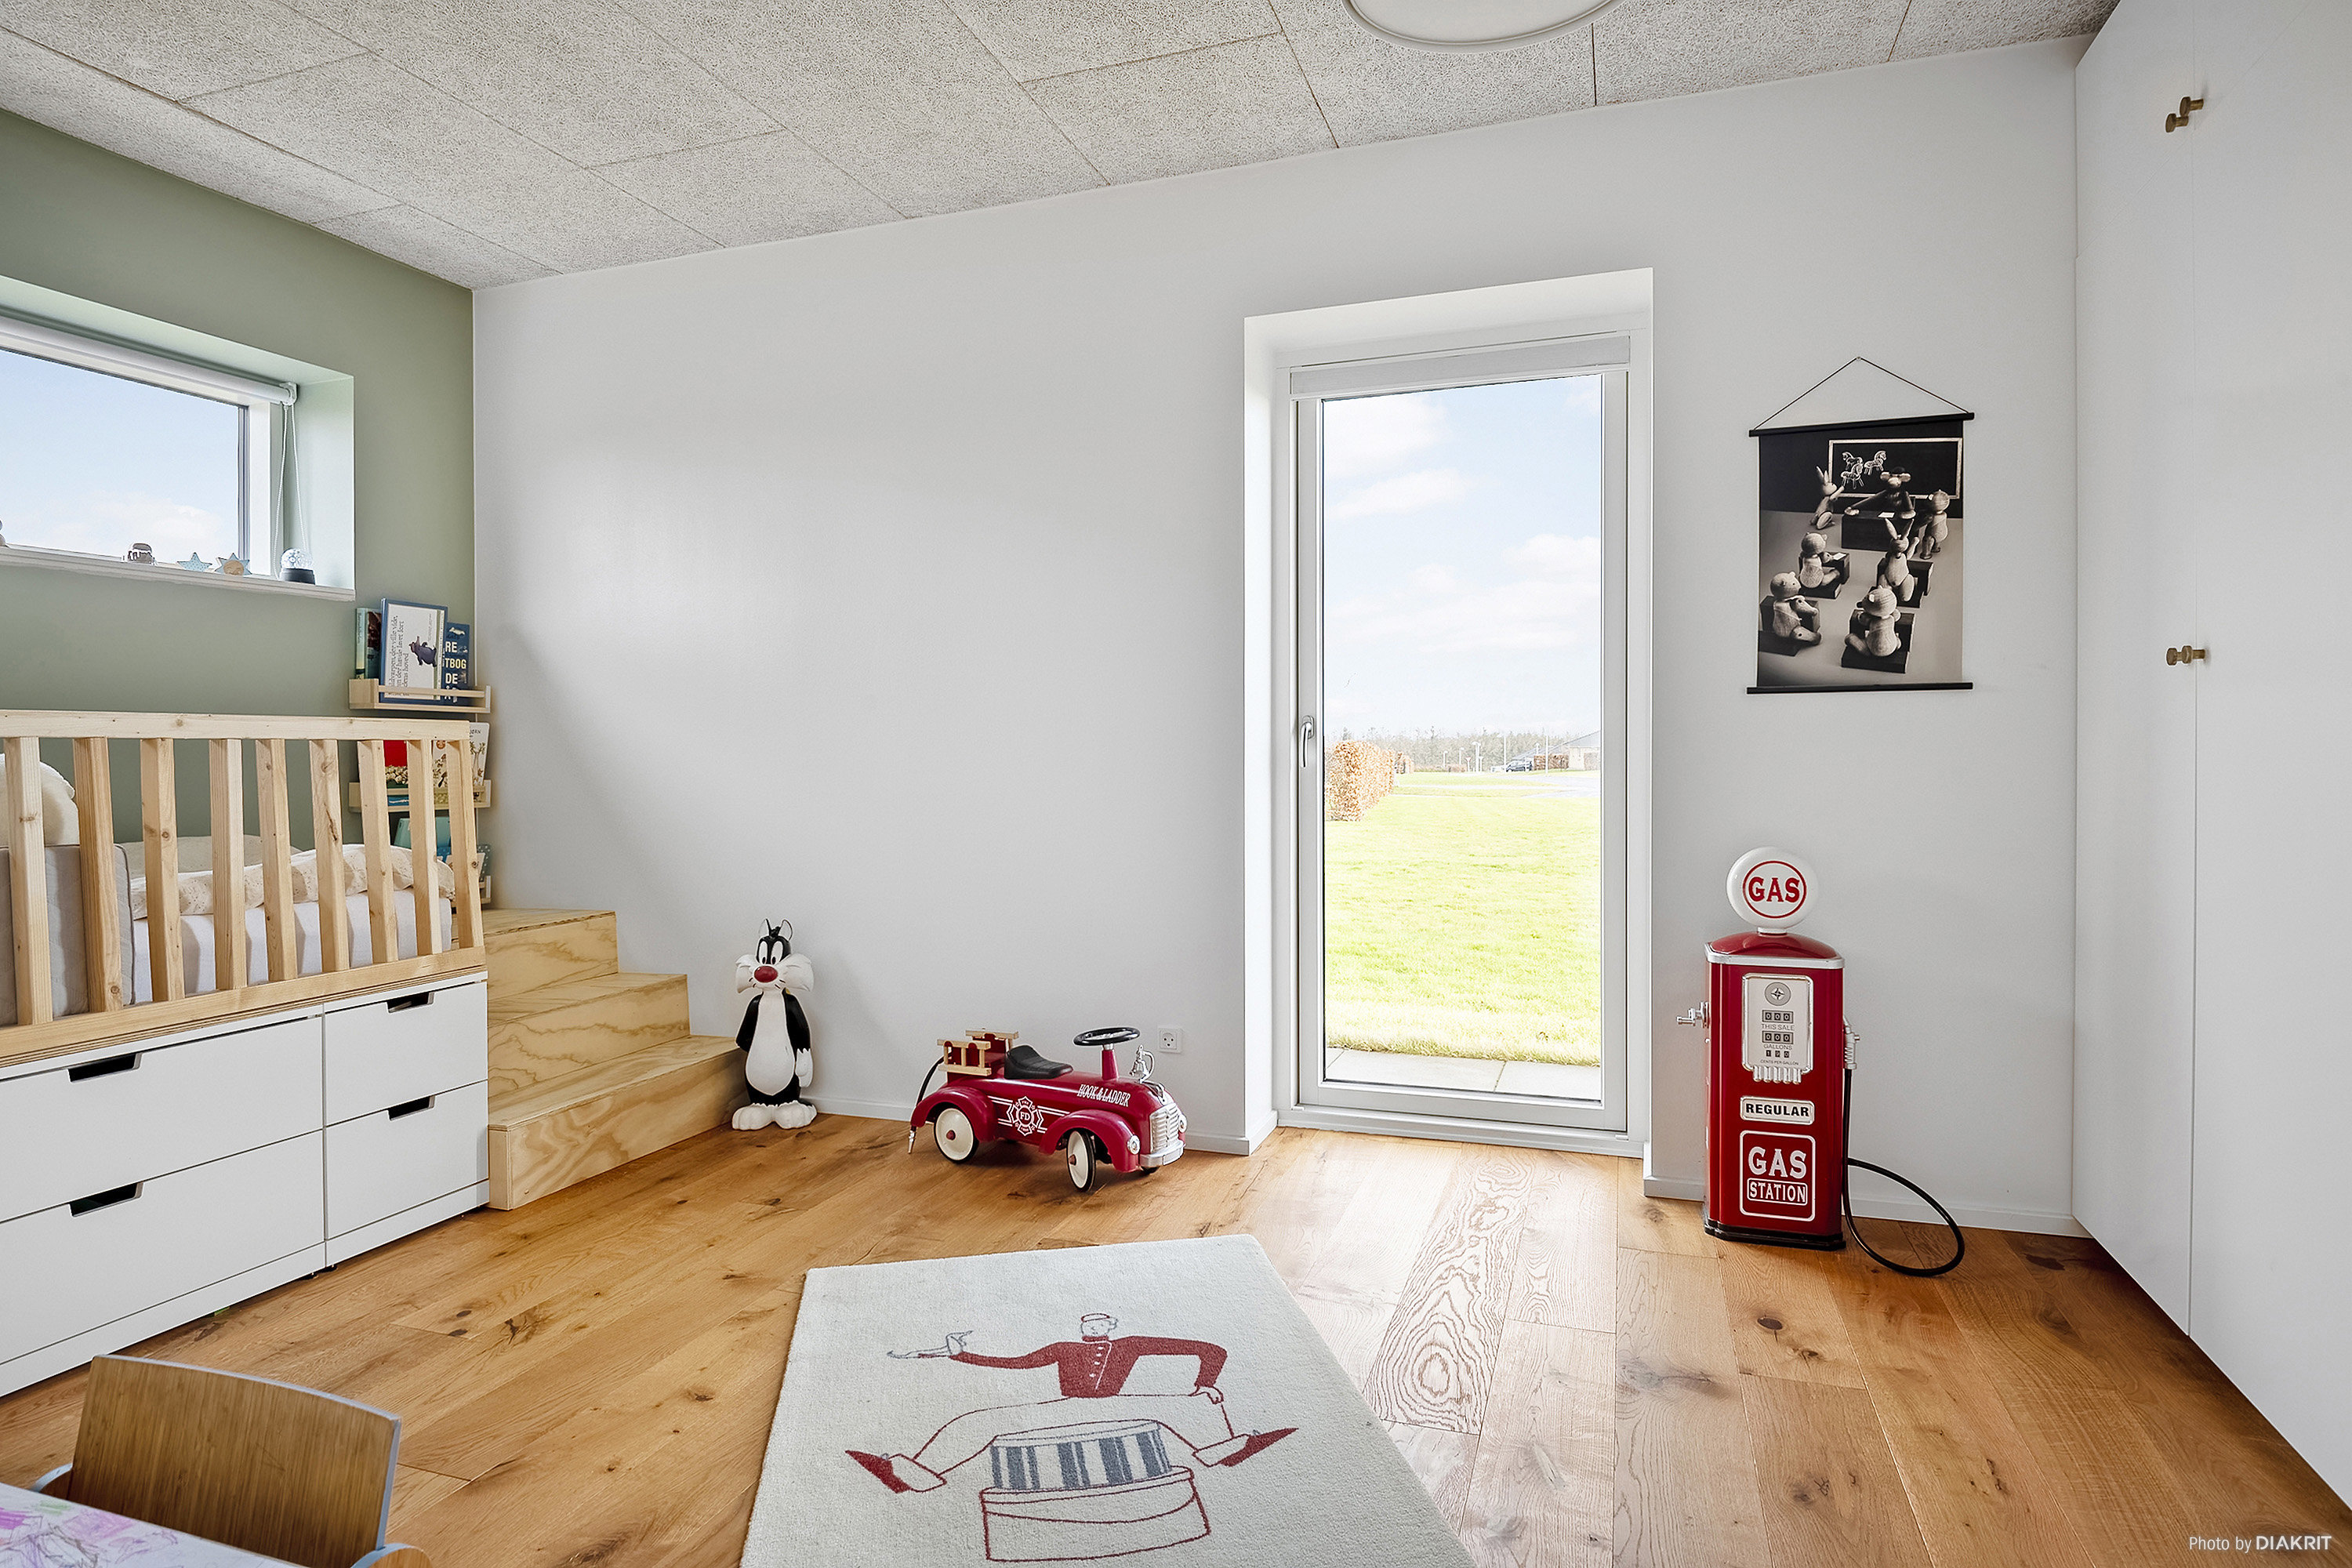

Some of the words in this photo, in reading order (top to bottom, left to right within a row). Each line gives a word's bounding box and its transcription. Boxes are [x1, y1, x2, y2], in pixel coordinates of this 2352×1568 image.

[445, 641, 458, 653] RE
[445, 658, 466, 670] TBOG
[388, 656, 397, 687] ldvarpen,
[445, 673, 458, 684] DE
[1748, 877, 1801, 903] GAS
[1020, 1111, 1031, 1121] FD
[1745, 1103, 1809, 1116] REGULAR
[1748, 1147, 1807, 1178] GAS
[1750, 1182, 1806, 1202] STATION
